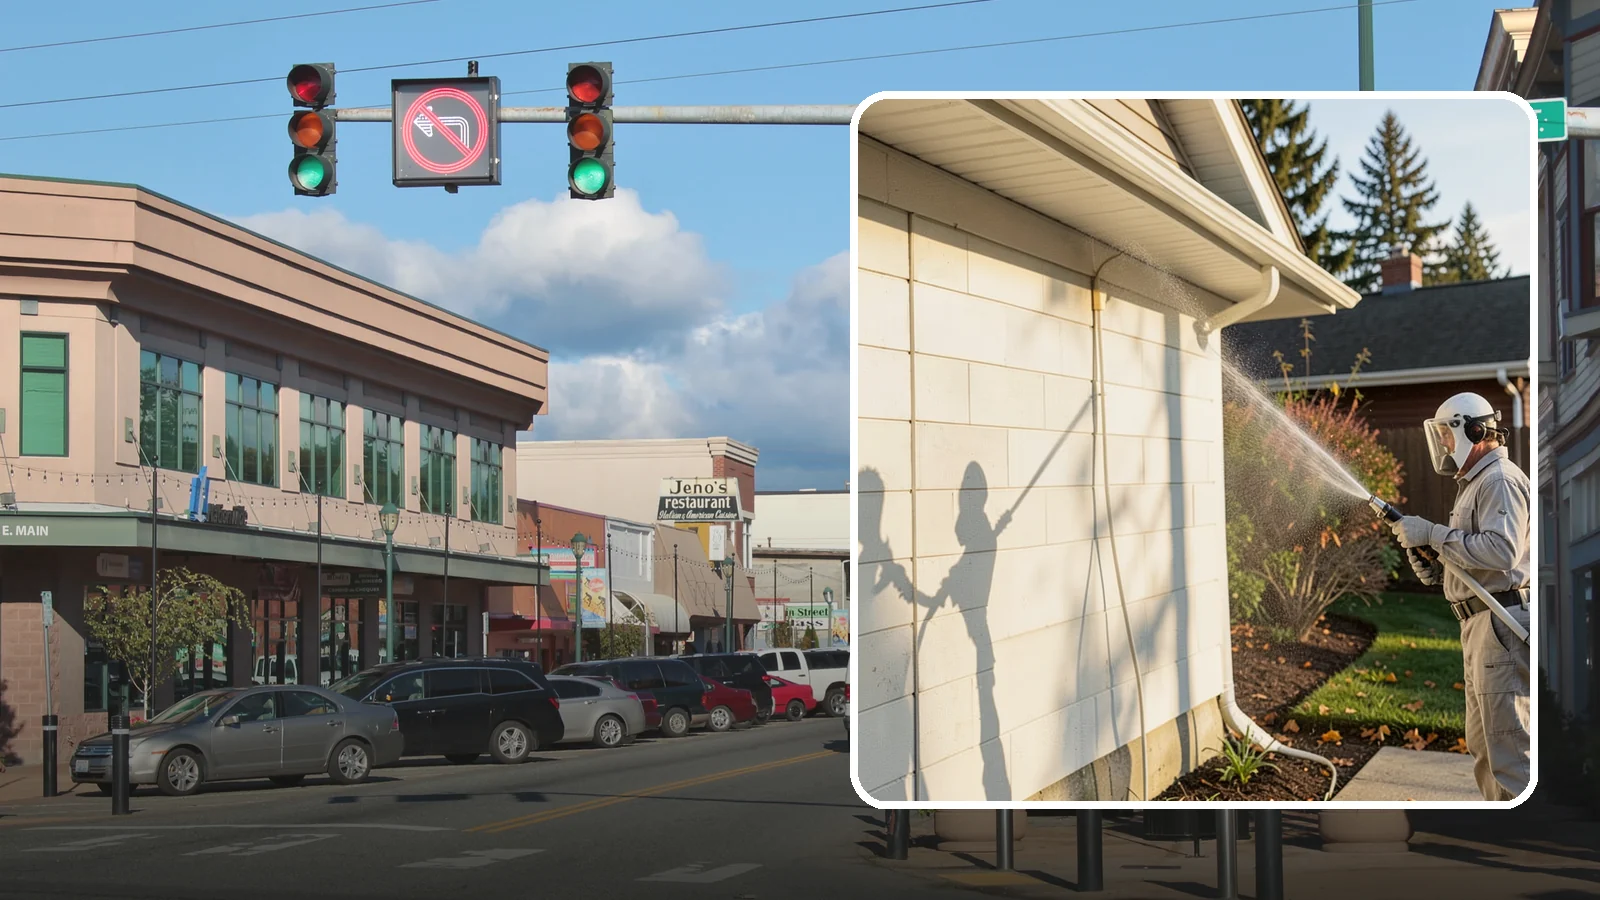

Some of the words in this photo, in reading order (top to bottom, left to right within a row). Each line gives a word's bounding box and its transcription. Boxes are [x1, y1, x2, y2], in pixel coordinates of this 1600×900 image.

[670, 480, 727, 494] Jeno's
[665, 496, 731, 509] restaurant
[659, 510, 682, 519] Italian
[686, 510, 714, 519] American
[715, 510, 737, 519] Cuisine
[2, 525, 13, 536] E.
[15, 525, 49, 536] MAIN
[797, 608, 828, 616] Street
